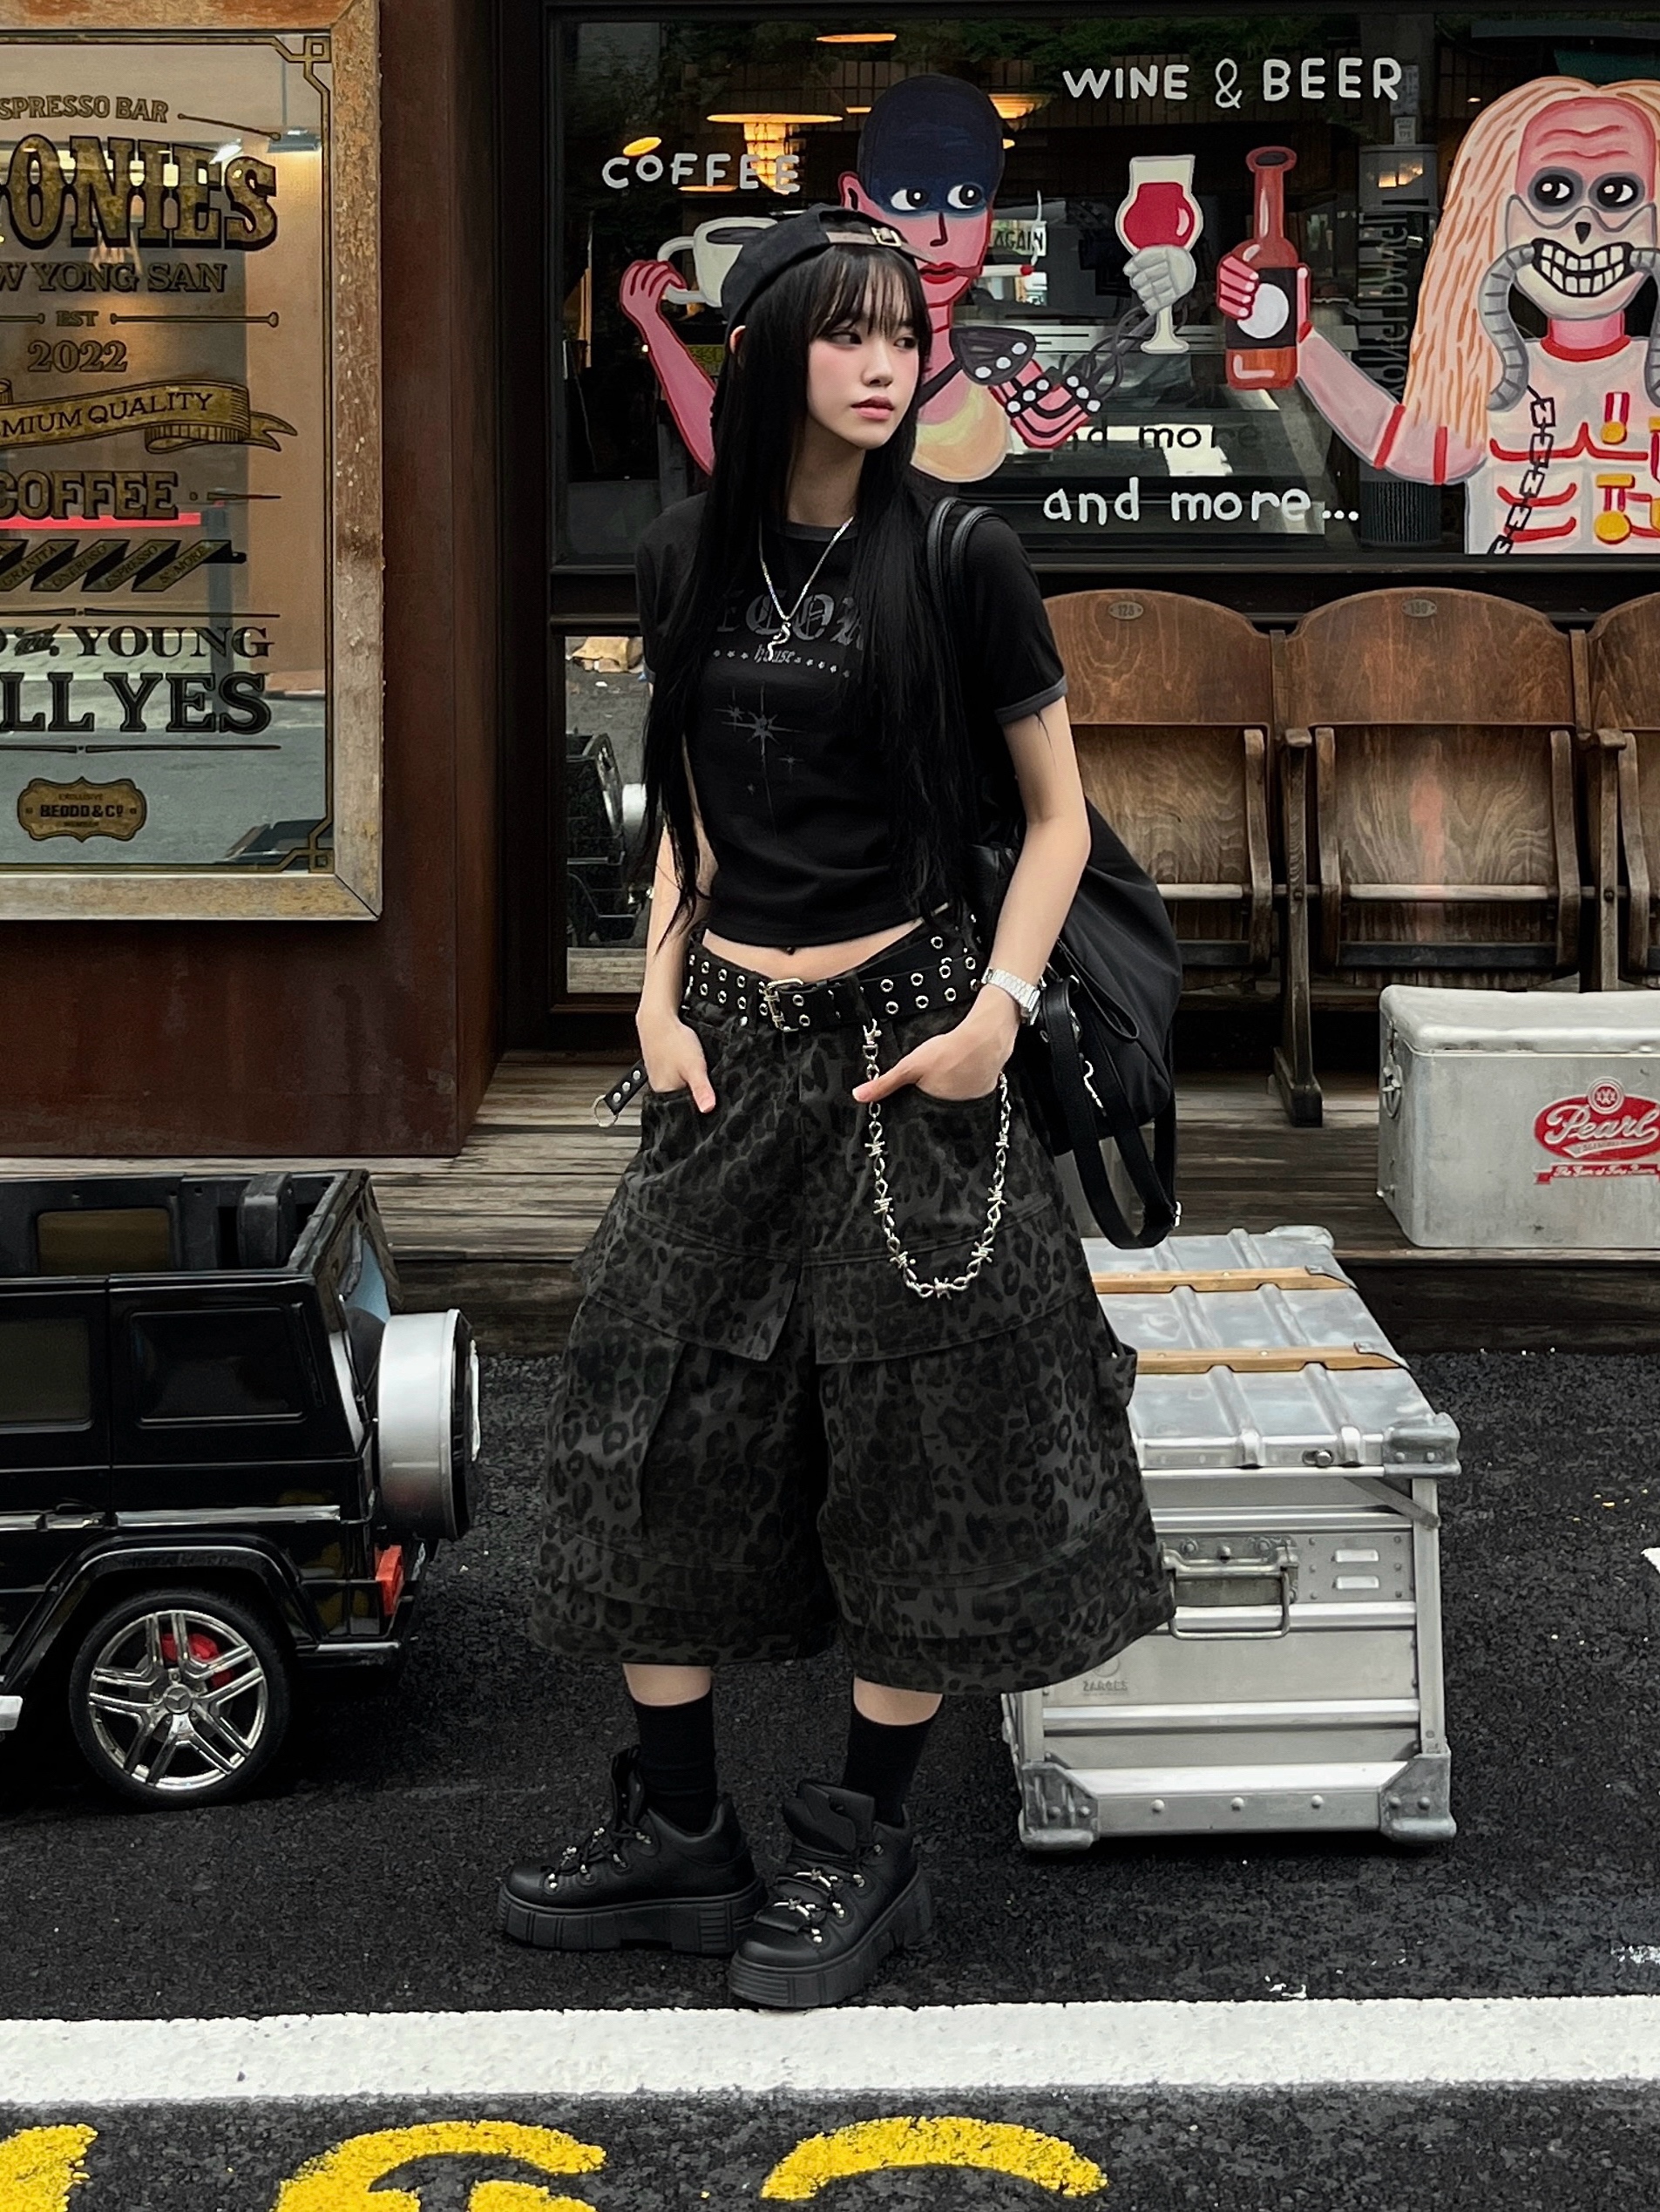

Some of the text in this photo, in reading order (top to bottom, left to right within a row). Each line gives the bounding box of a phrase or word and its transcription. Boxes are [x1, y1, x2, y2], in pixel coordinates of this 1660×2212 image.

[1062, 64, 1190, 101] WINE
[1215, 57, 1243, 110] &
[1263, 57, 1403, 102] BEER
[115, 96, 169, 124] BAR
[601, 152, 801, 193] COFFEE
[993, 229, 1044, 253] AGAIN
[30, 261, 139, 293] YONG
[147, 262, 228, 294] SAN
[56, 310, 99, 327] EST
[27, 339, 128, 374] 2022
[88, 391, 213, 424] QUALITY
[0, 470, 180, 521] COFFEE
[1043, 476, 1141, 525] and
[68, 626, 275, 659] YOUNG
[103, 671, 273, 735] YES
[1543, 1104, 1660, 1146] Pearl
